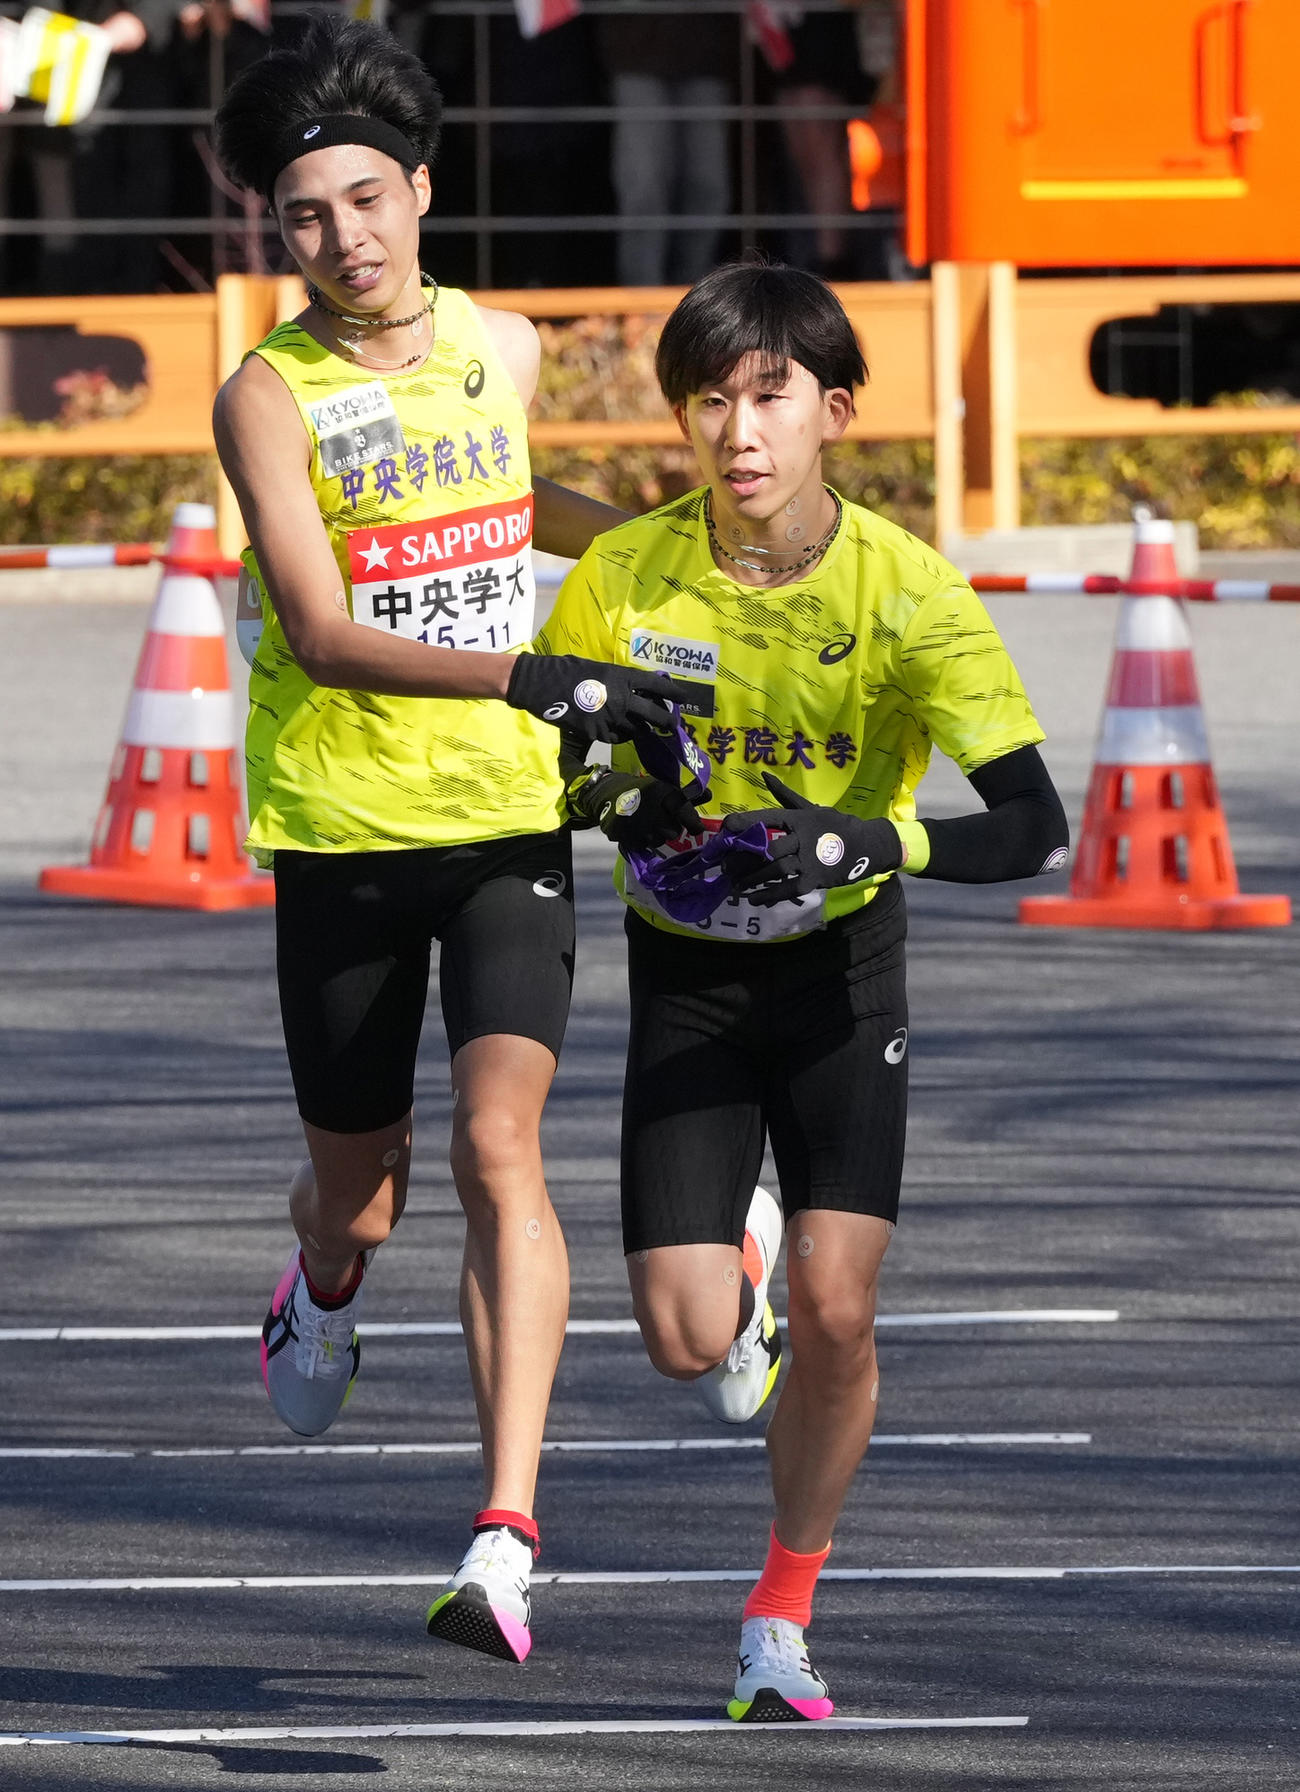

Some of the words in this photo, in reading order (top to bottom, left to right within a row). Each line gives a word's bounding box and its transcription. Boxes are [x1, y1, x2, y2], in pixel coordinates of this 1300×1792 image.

[334, 452, 361, 468] BIKE
[341, 423, 512, 511] 中央学院大学
[401, 506, 532, 568] SAPPORO
[372, 558, 526, 630] 中央学大
[416, 620, 510, 651] 15-11
[653, 641, 715, 666] KYOWA
